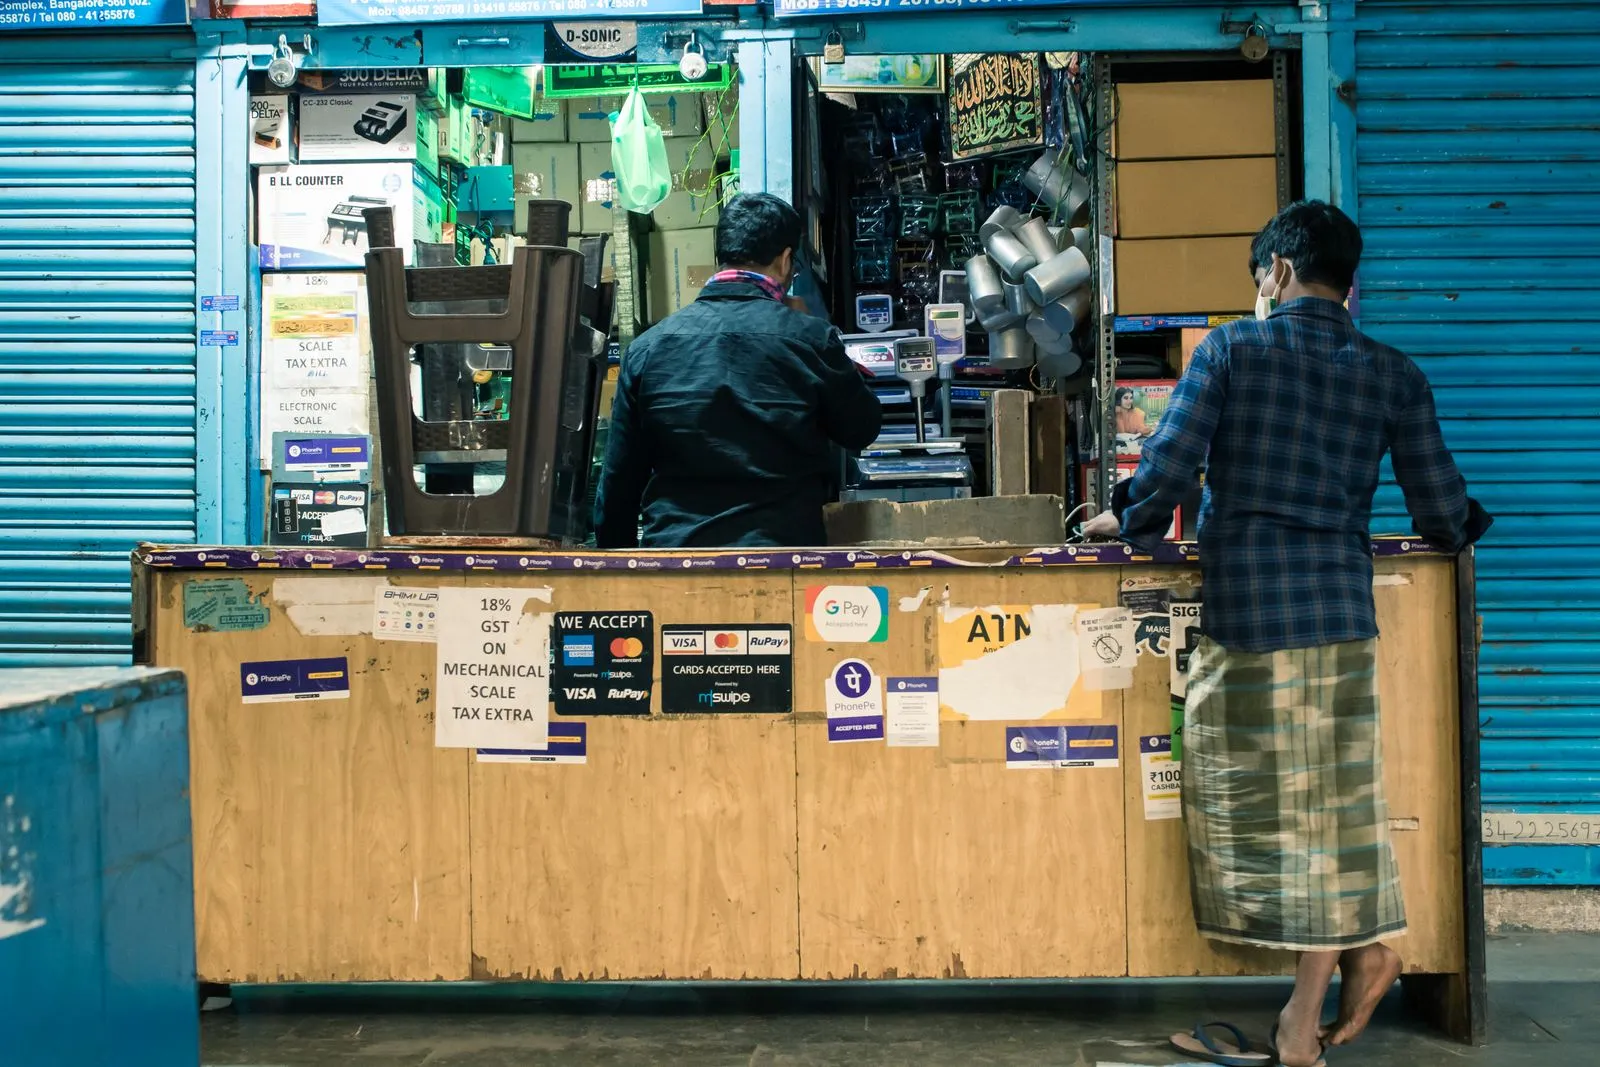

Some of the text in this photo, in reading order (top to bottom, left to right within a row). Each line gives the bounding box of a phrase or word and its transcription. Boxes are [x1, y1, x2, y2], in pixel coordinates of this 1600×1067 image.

[39, 12, 54, 22] Tel
[58, 11, 75, 21] 080
[85, 9, 135, 20] 41255876
[368, 6, 394, 16] Mob:
[566, 29, 621, 43] D-SONIC
[373, 68, 423, 81] DELTA
[251, 101, 269, 110] 200
[251, 109, 281, 119] DELTA
[269, 175, 344, 186] BLL COUNTER
[299, 341, 333, 351] SCALE
[286, 358, 348, 369] TAX EXTRA
[300, 388, 316, 397] ON
[279, 402, 337, 411] ELECTRONIC
[293, 416, 322, 424] SCALE
[480, 598, 512, 612] 18%
[825, 599, 869, 618] G Pay
[1172, 606, 1201, 617] SIG
[481, 620, 510, 633] GST
[559, 616, 648, 629] WE ACCEPT
[672, 638, 698, 647] VISA
[750, 637, 783, 648] RuPay
[482, 642, 506, 655] ON
[443, 662, 545, 678] MECHANICAL
[673, 665, 780, 675] CARDS ACCEPTED HERE
[261, 673, 292, 682] PhonePe
[470, 685, 516, 699] SCALE
[563, 688, 645, 701] VISA RuPay
[834, 701, 876, 711] PhonePe
[452, 706, 534, 721] TAX EXTRA
[835, 723, 878, 732] ACCEPTED HERE
[1151, 783, 1180, 791] CASHBA
